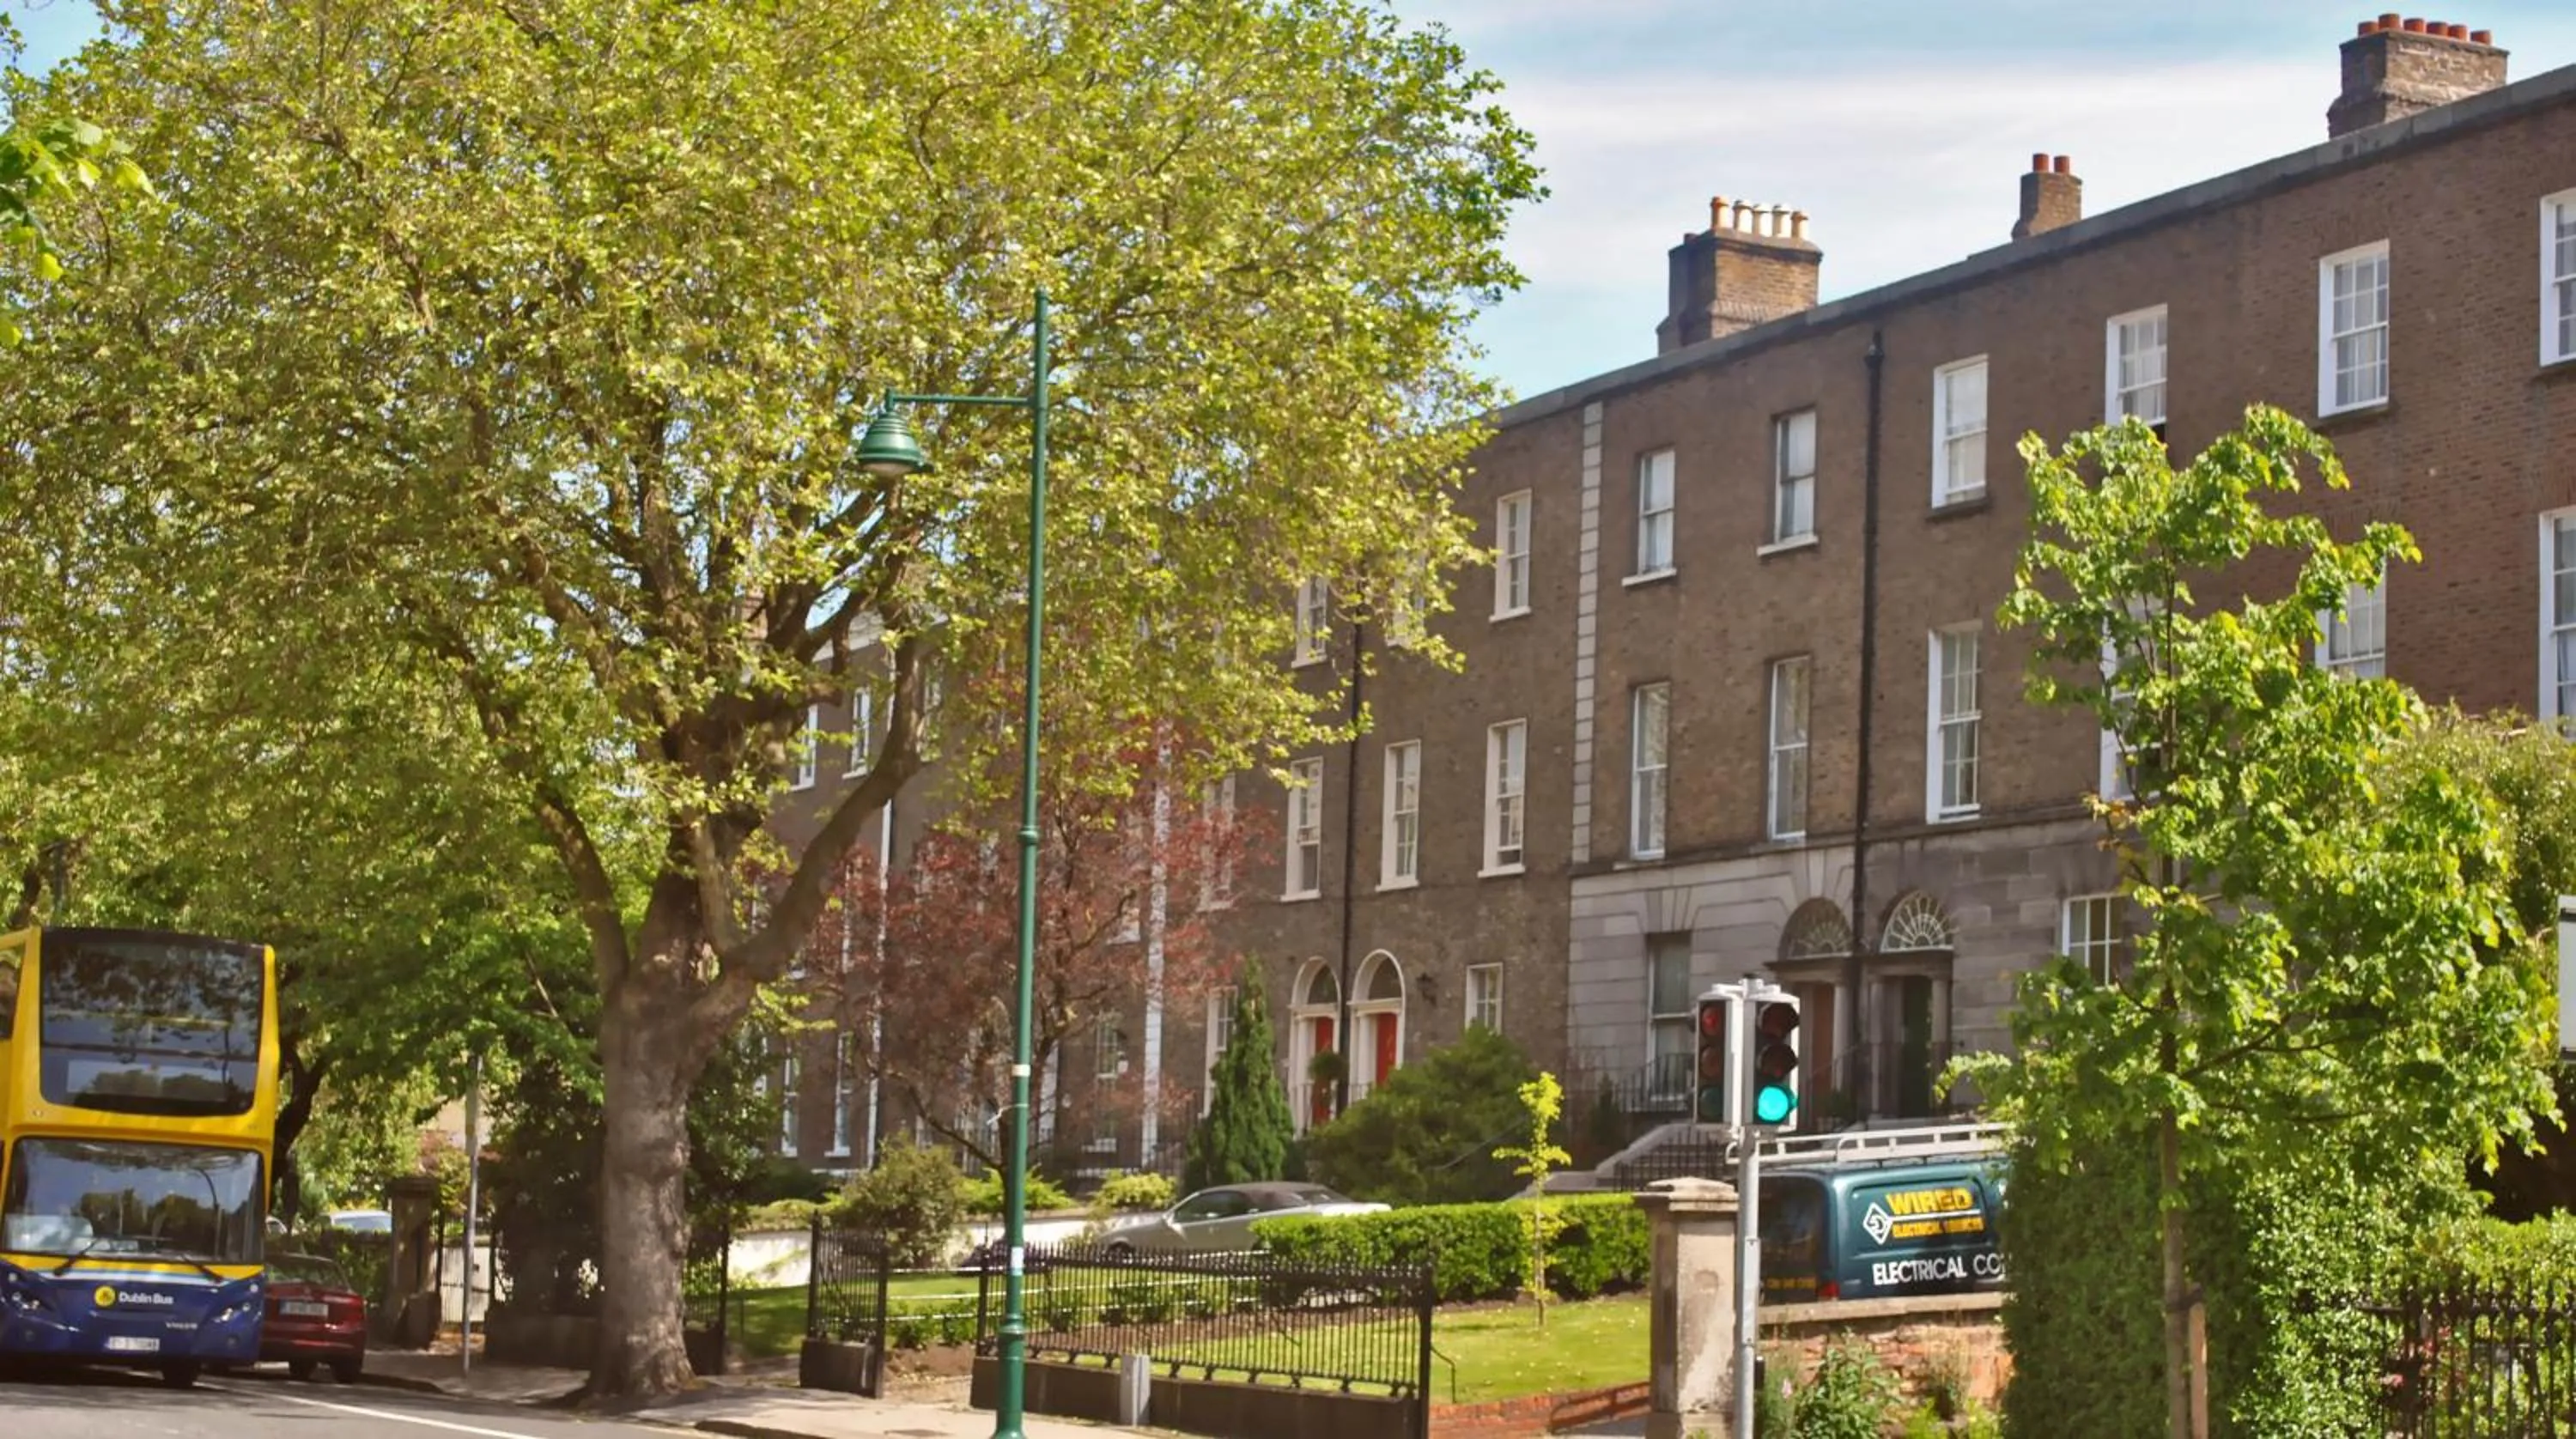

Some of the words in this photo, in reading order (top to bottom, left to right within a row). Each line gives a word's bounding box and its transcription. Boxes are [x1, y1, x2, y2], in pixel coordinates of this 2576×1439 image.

[1886, 1187, 1973, 1214] WIRED
[1872, 1256, 1967, 1285] ELECTRICAL
[119, 1291, 151, 1303] Dublin
[153, 1293, 173, 1304] Bus
